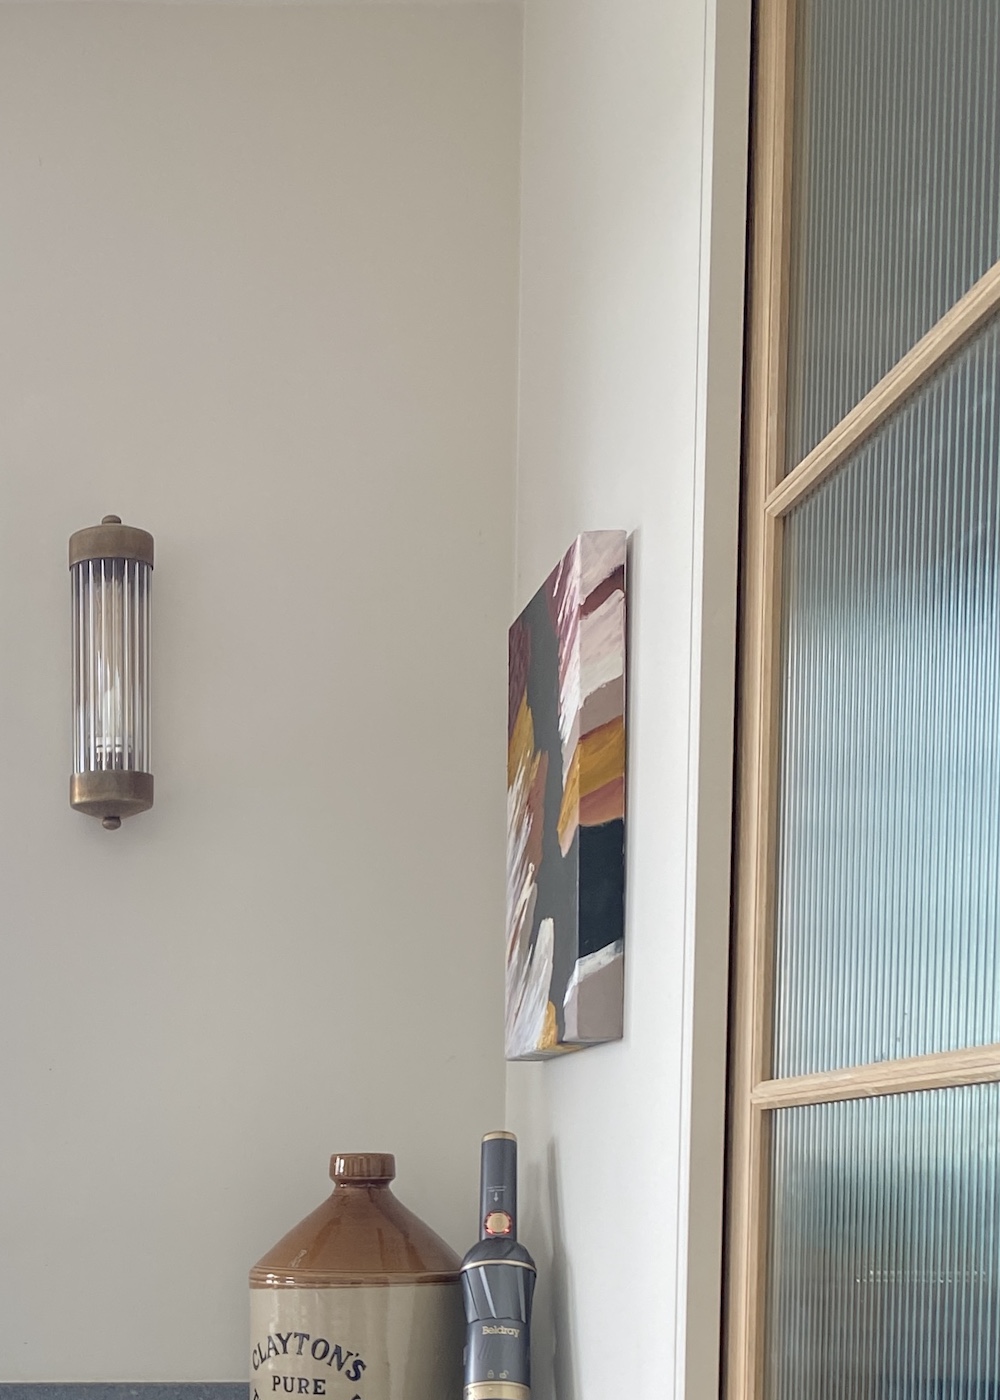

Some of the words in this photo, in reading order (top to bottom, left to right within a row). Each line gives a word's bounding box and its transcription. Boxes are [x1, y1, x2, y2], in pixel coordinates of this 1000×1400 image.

[482, 1325, 520, 1338] Beldray
[252, 1332, 367, 1382] CLAYTON'S
[272, 1375, 326, 1395] PURE
